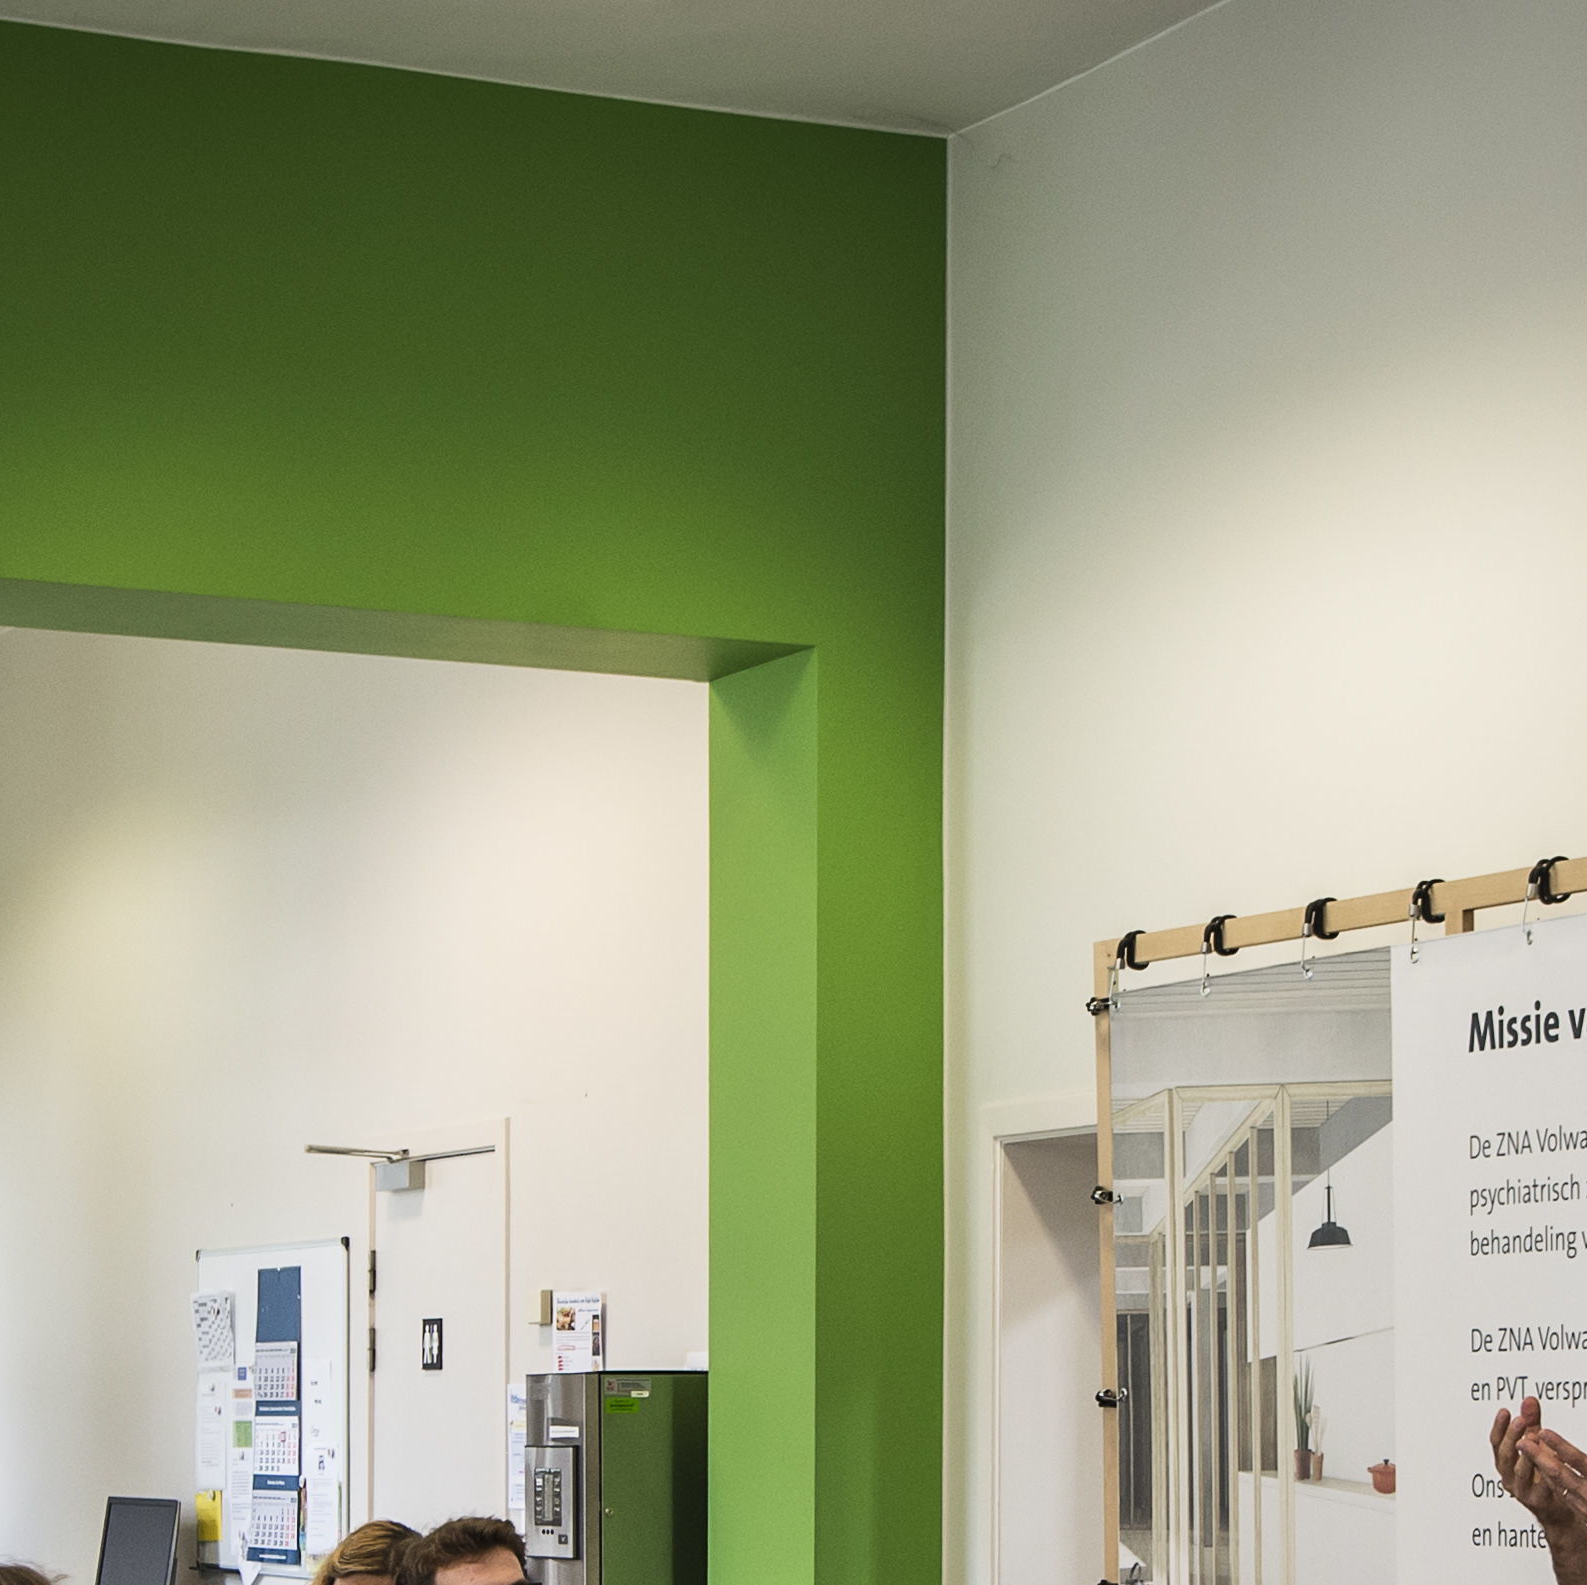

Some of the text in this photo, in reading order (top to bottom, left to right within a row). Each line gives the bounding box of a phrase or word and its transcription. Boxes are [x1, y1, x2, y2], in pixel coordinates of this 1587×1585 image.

[1468, 1000, 1559, 1053] Missie
[1469, 1135, 1491, 1159] De
[1496, 1130, 1532, 1157] ZNA
[1470, 1173, 1580, 1216] psychiatrisch
[1470, 1229, 1577, 1259] behandeling
[1471, 1328, 1492, 1352] De
[1498, 1327, 1534, 1351] ZNA
[1471, 1382, 1490, 1400] en
[1497, 1376, 1528, 1400] PVT
[1472, 1473, 1504, 1498] Ons
[1472, 1521, 1546, 1548] en hante
